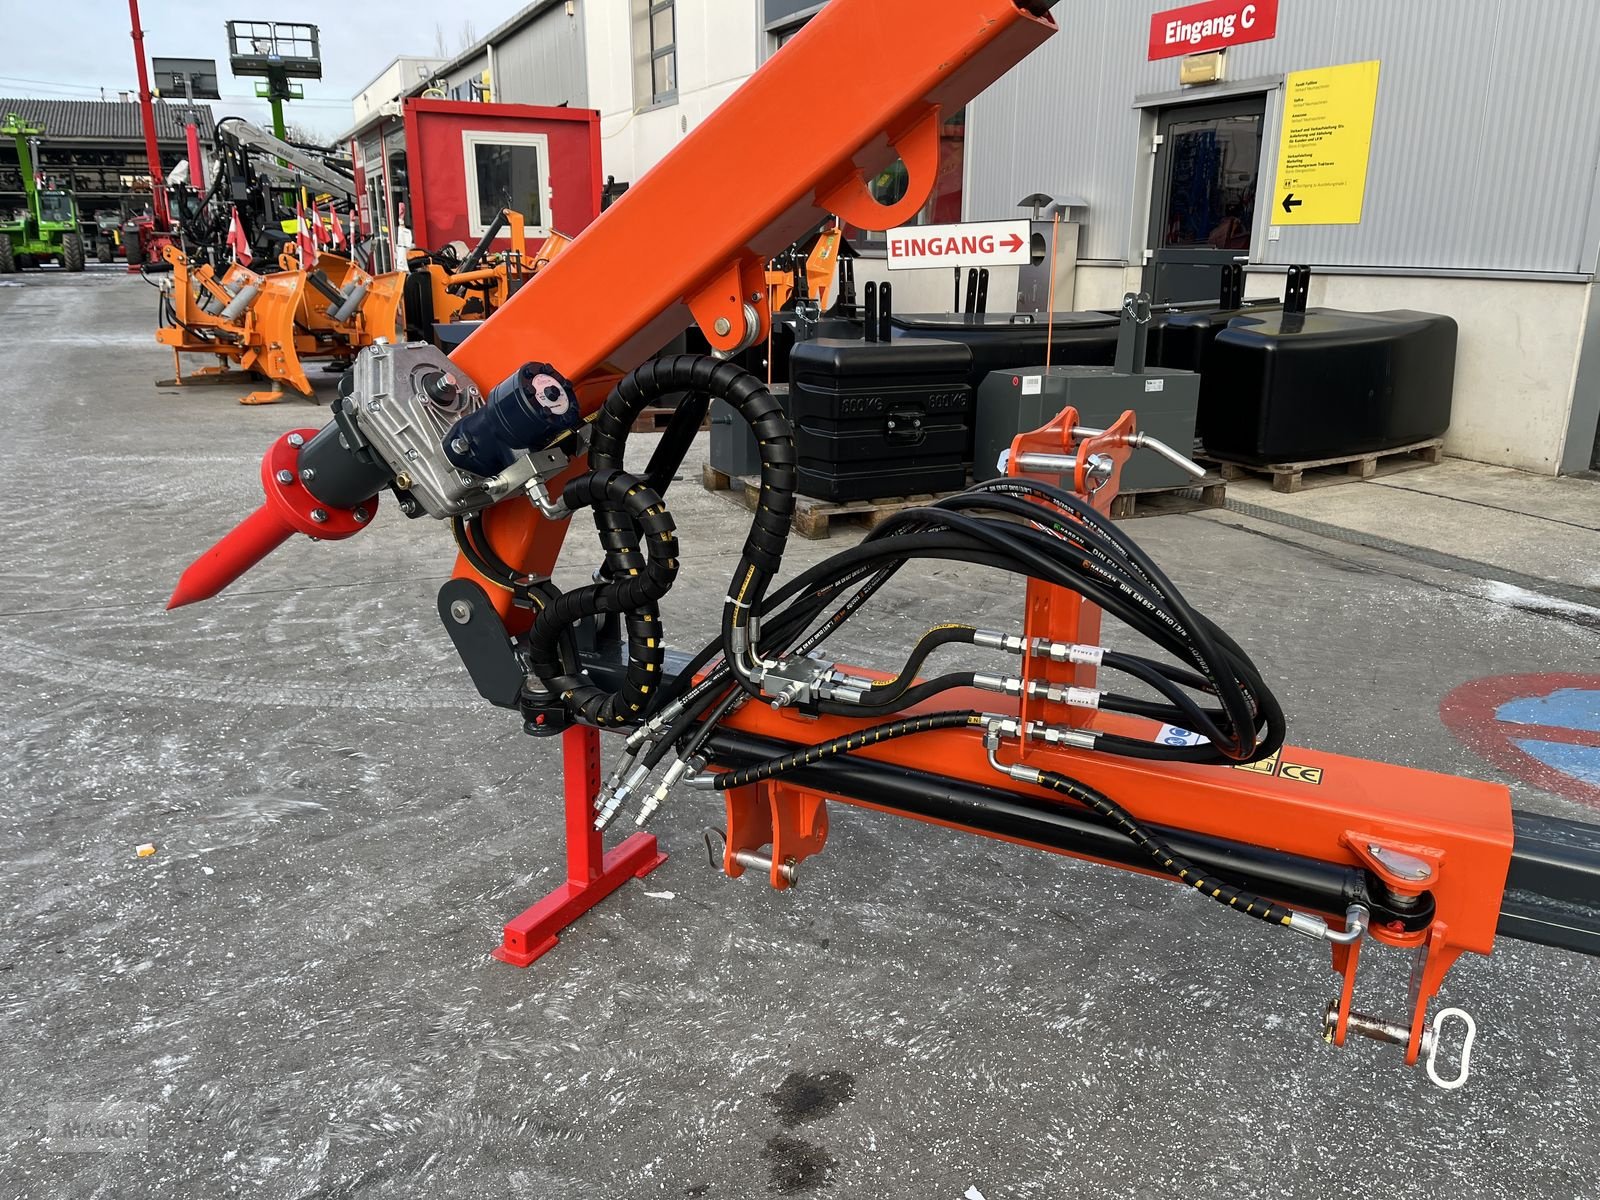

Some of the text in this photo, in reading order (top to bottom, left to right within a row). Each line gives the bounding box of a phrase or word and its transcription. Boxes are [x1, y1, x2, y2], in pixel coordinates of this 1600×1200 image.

[1165, 4, 1256, 45] Eingang C
[891, 235, 995, 257] EINGANG
[1092, 548, 1107, 561] DIN
[1119, 582, 1132, 596] DIN
[1132, 591, 1143, 603] EN
[1142, 599, 1157, 612] 857
[1155, 608, 1175, 627] DN10
[1282, 766, 1320, 783] CE
